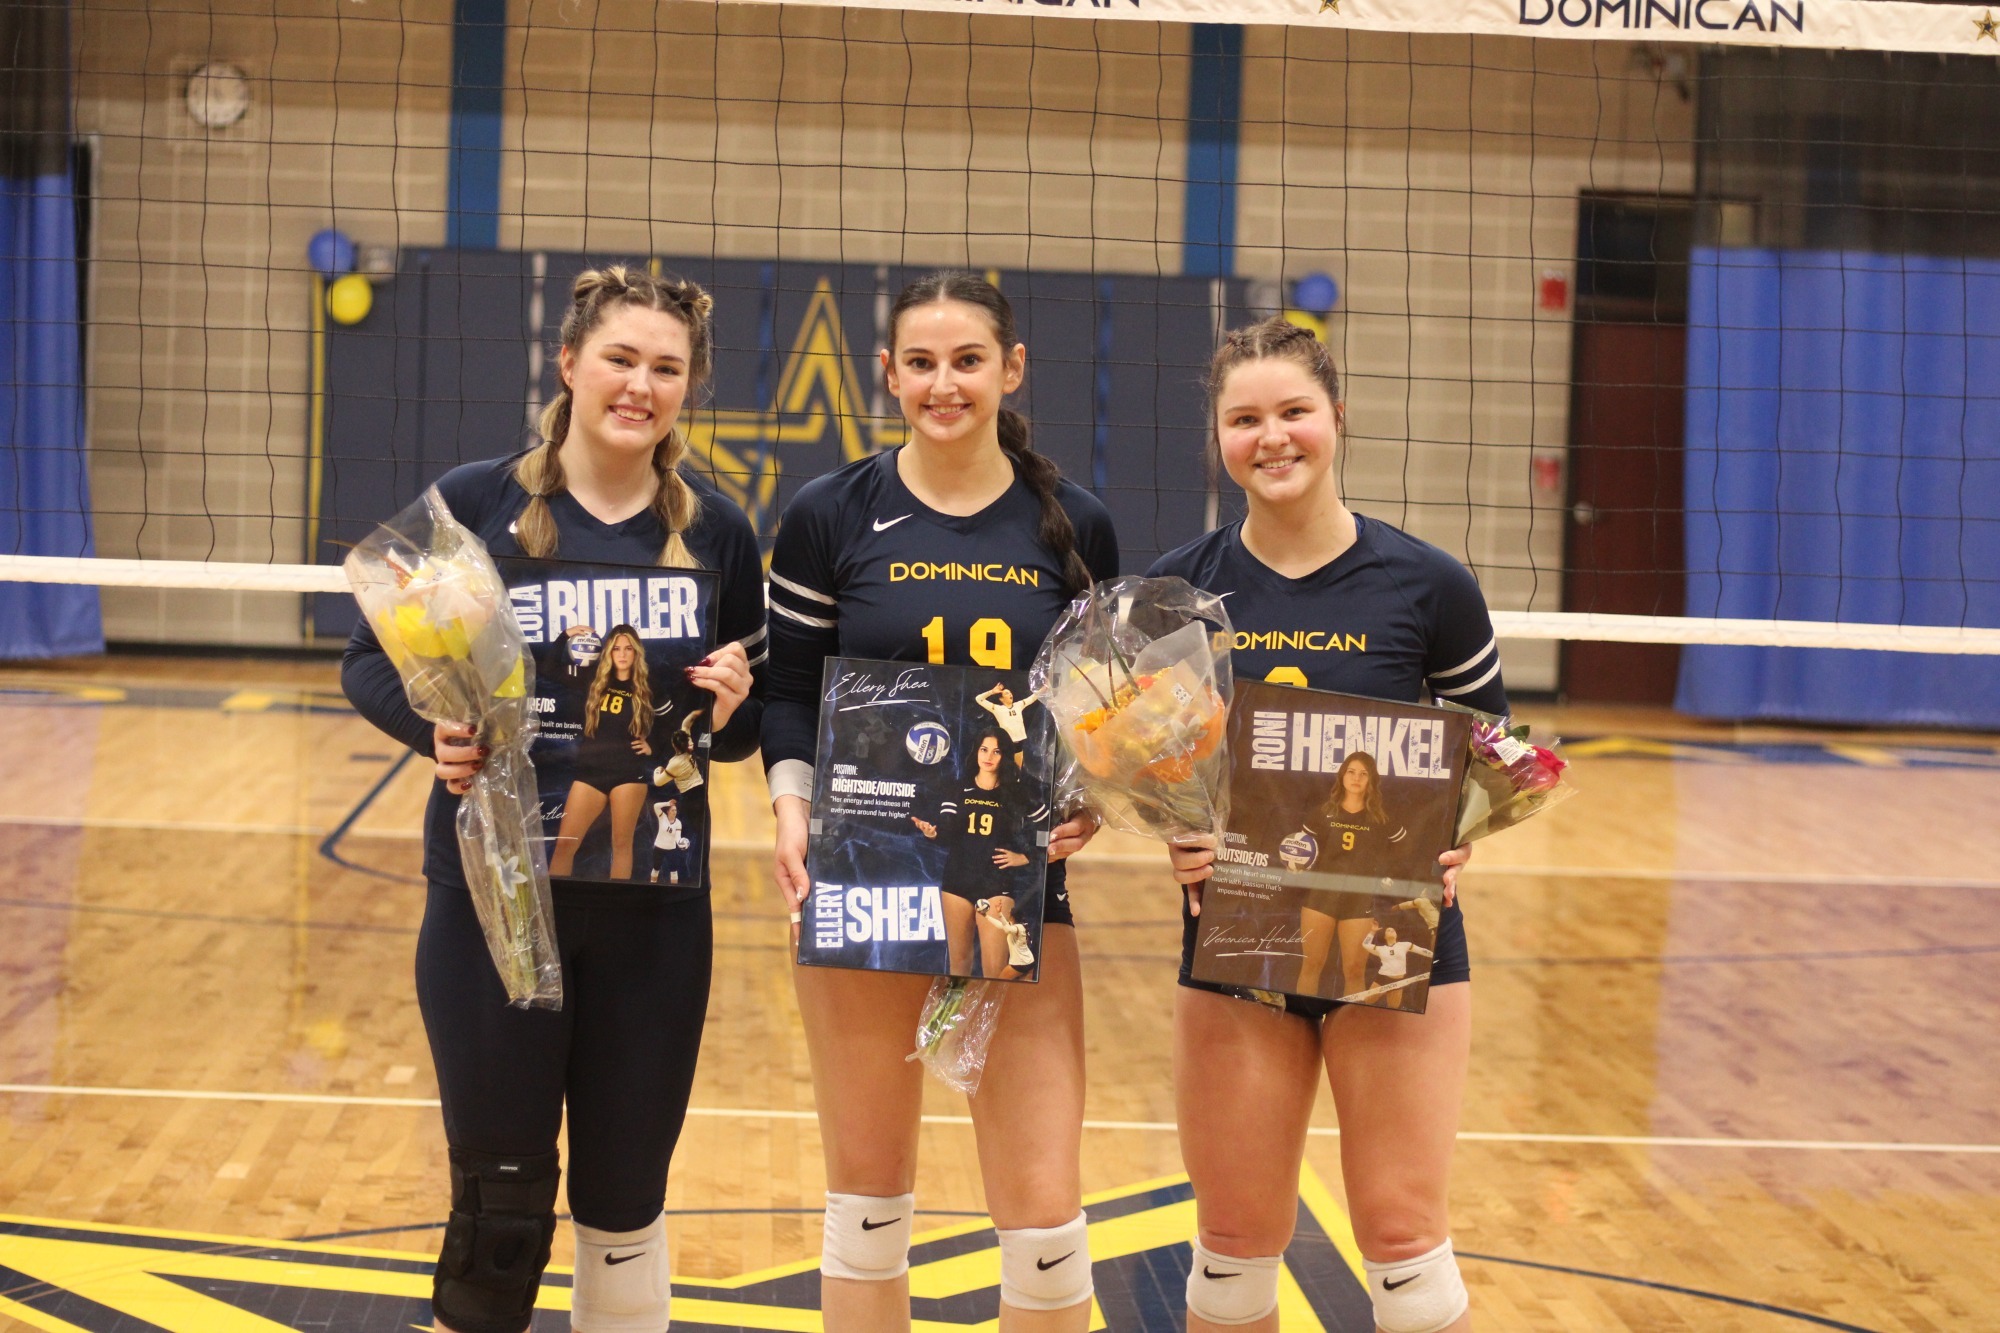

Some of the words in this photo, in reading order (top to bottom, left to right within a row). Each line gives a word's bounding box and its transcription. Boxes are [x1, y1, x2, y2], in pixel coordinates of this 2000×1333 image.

[1519, 0, 1804, 33] DOMINICAN
[890, 562, 1039, 588] DOMINICAN
[509, 584, 544, 643] LOLA
[547, 576, 701, 642] BUTLER
[921, 616, 1012, 670] 19
[1213, 631, 1366, 652] DOMINICAN
[824, 672, 887, 702] Ellery
[888, 667, 930, 698] Shea
[600, 693, 624, 714] 18
[541, 720, 555, 728] built
[1251, 711, 1288, 771] RONI
[1290, 712, 1451, 779] HENKEL
[833, 763, 859, 776] POSITION:
[831, 777, 917, 798] RIGHTSIDE/OUTSIDE
[830, 807, 857, 815] everyone
[877, 809, 887, 817] her
[843, 797, 863, 806] energy
[863, 798, 875, 806] and
[875, 799, 901, 808] kindness
[964, 798, 1001, 808] DOMINICA
[967, 812, 993, 836] 19
[1330, 821, 1370, 832] DOMINICAN
[1341, 831, 1355, 851] 9
[1217, 847, 1269, 867] OUTSIDE/DS
[1211, 876, 1228, 884] touch
[1228, 877, 1242, 886] with
[1242, 880, 1265, 889] passion
[1230, 867, 1242, 875] with
[1243, 869, 1259, 878] heart
[1266, 874, 1282, 882] every
[815, 881, 844, 948] ELLERY
[845, 886, 947, 943] SHEA
[1203, 924, 1257, 947] Veronica
[1255, 924, 1314, 952] Henkel
